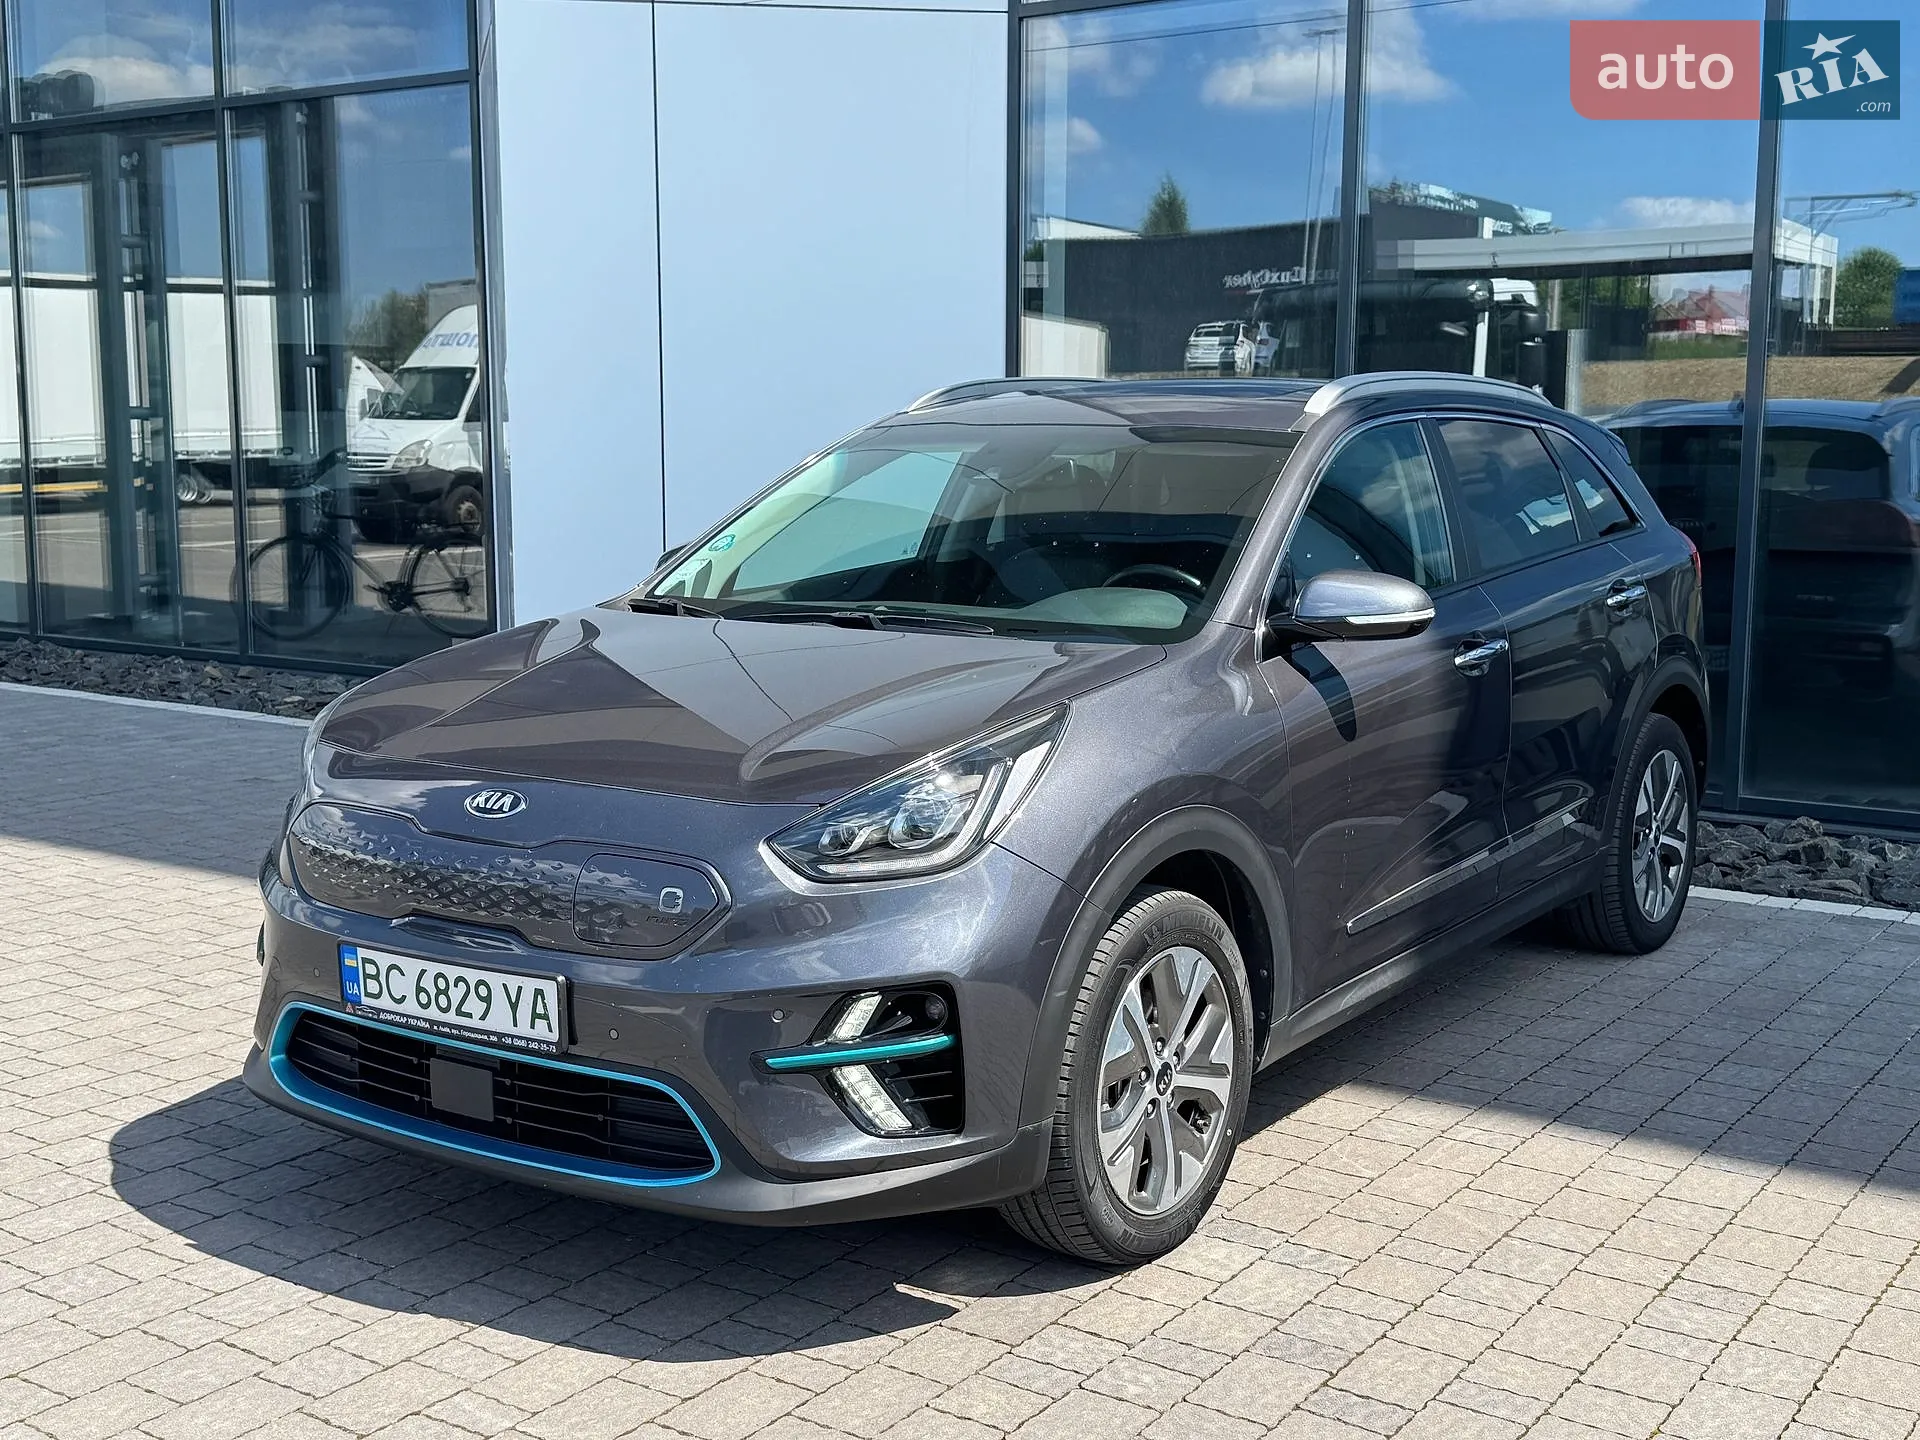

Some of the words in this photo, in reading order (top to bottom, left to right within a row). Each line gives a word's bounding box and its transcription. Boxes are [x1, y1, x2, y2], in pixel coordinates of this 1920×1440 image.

[472, 791, 515, 812] KIA
[346, 981, 360, 996] UA
[361, 957, 407, 1005] BC
[415, 968, 493, 1021] 6829
[502, 982, 554, 1033] YA
